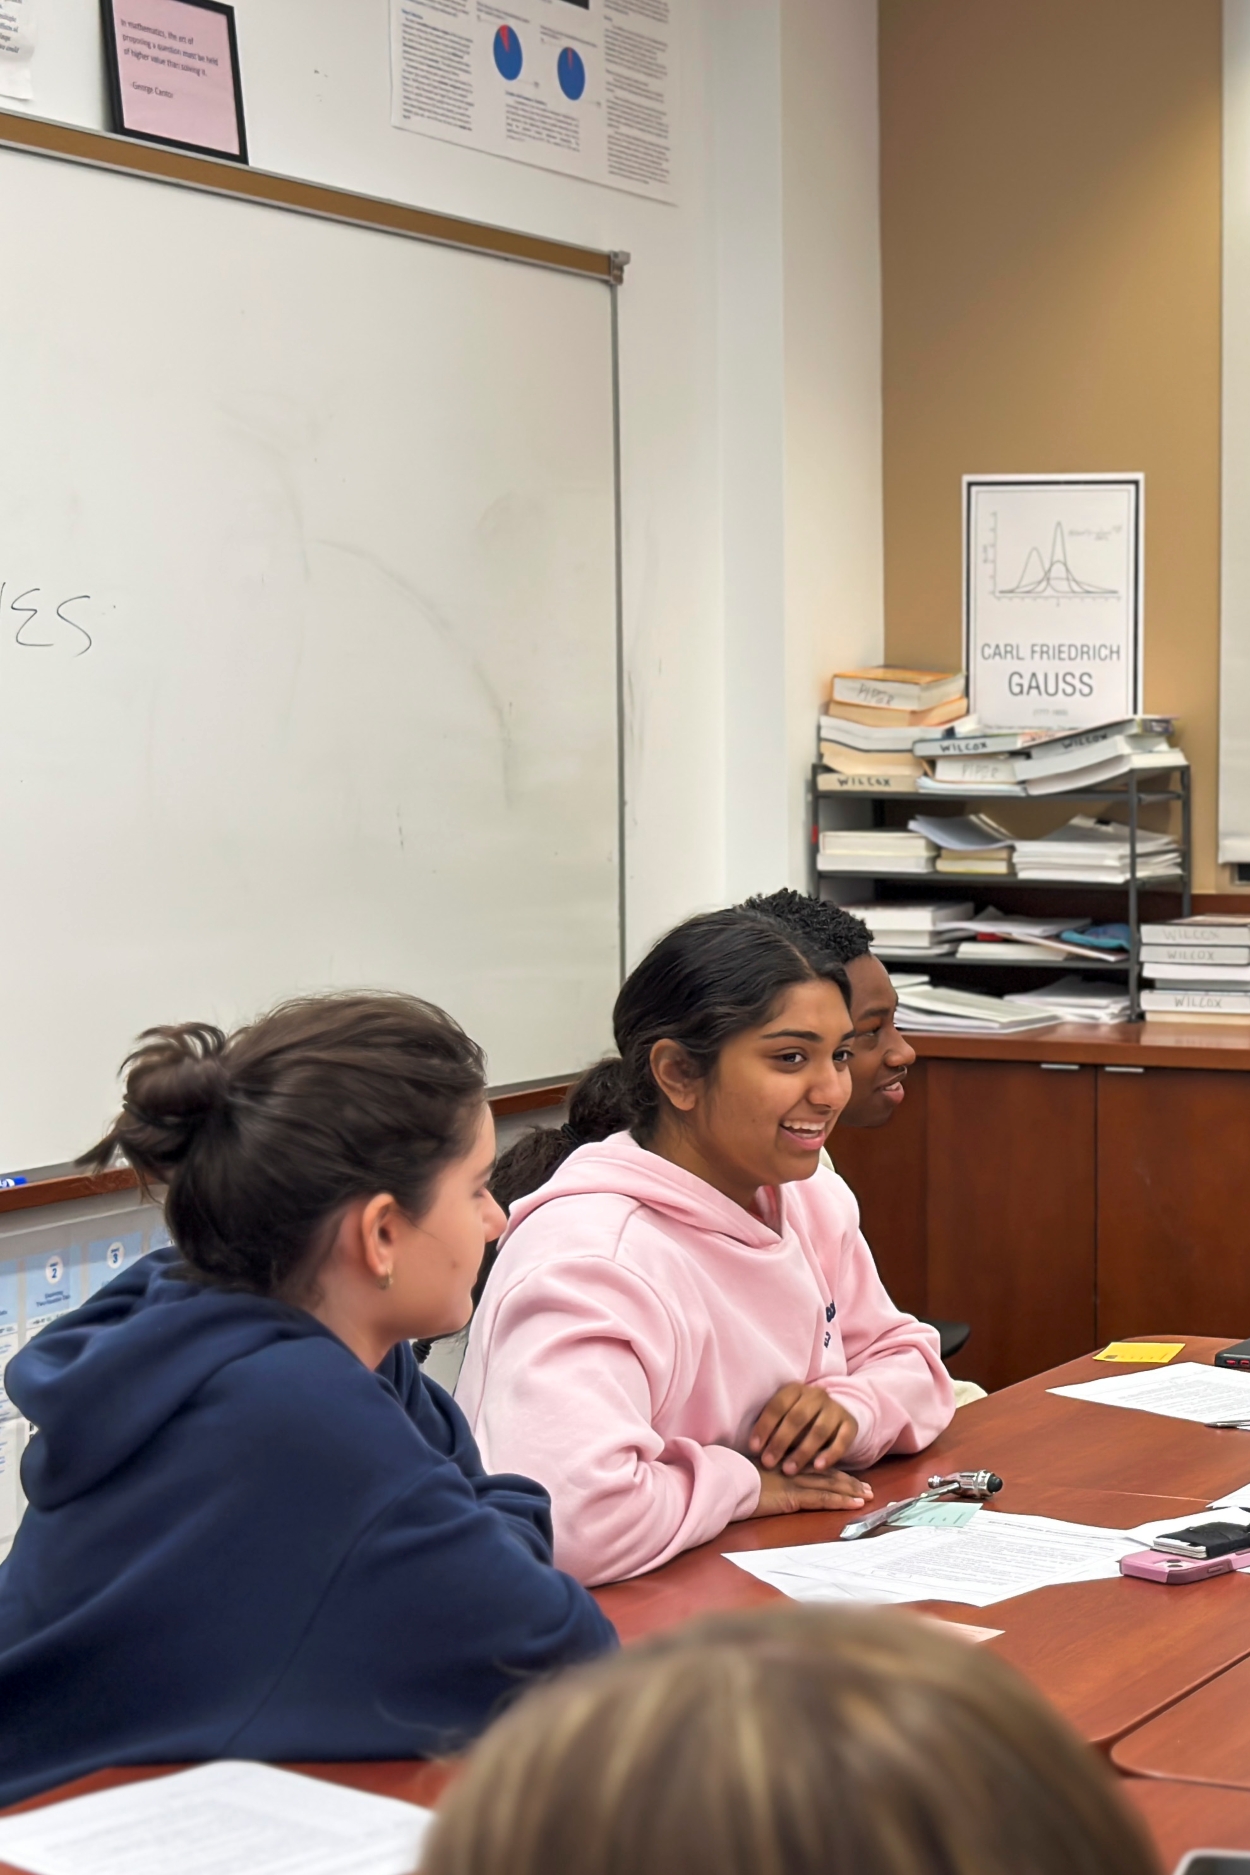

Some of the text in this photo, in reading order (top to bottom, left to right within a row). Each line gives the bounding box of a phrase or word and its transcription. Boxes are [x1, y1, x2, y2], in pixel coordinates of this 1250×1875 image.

[0, 581, 92, 657] ES
[981, 643, 1121, 661] CARL FRIEDRICH
[1008, 671, 1094, 697] GAUSS
[940, 741, 988, 753] WILCOX
[1166, 950, 1215, 961] WILCOX
[1174, 995, 1222, 1008] WILCOX
[51, 1268, 57, 1278] 2
